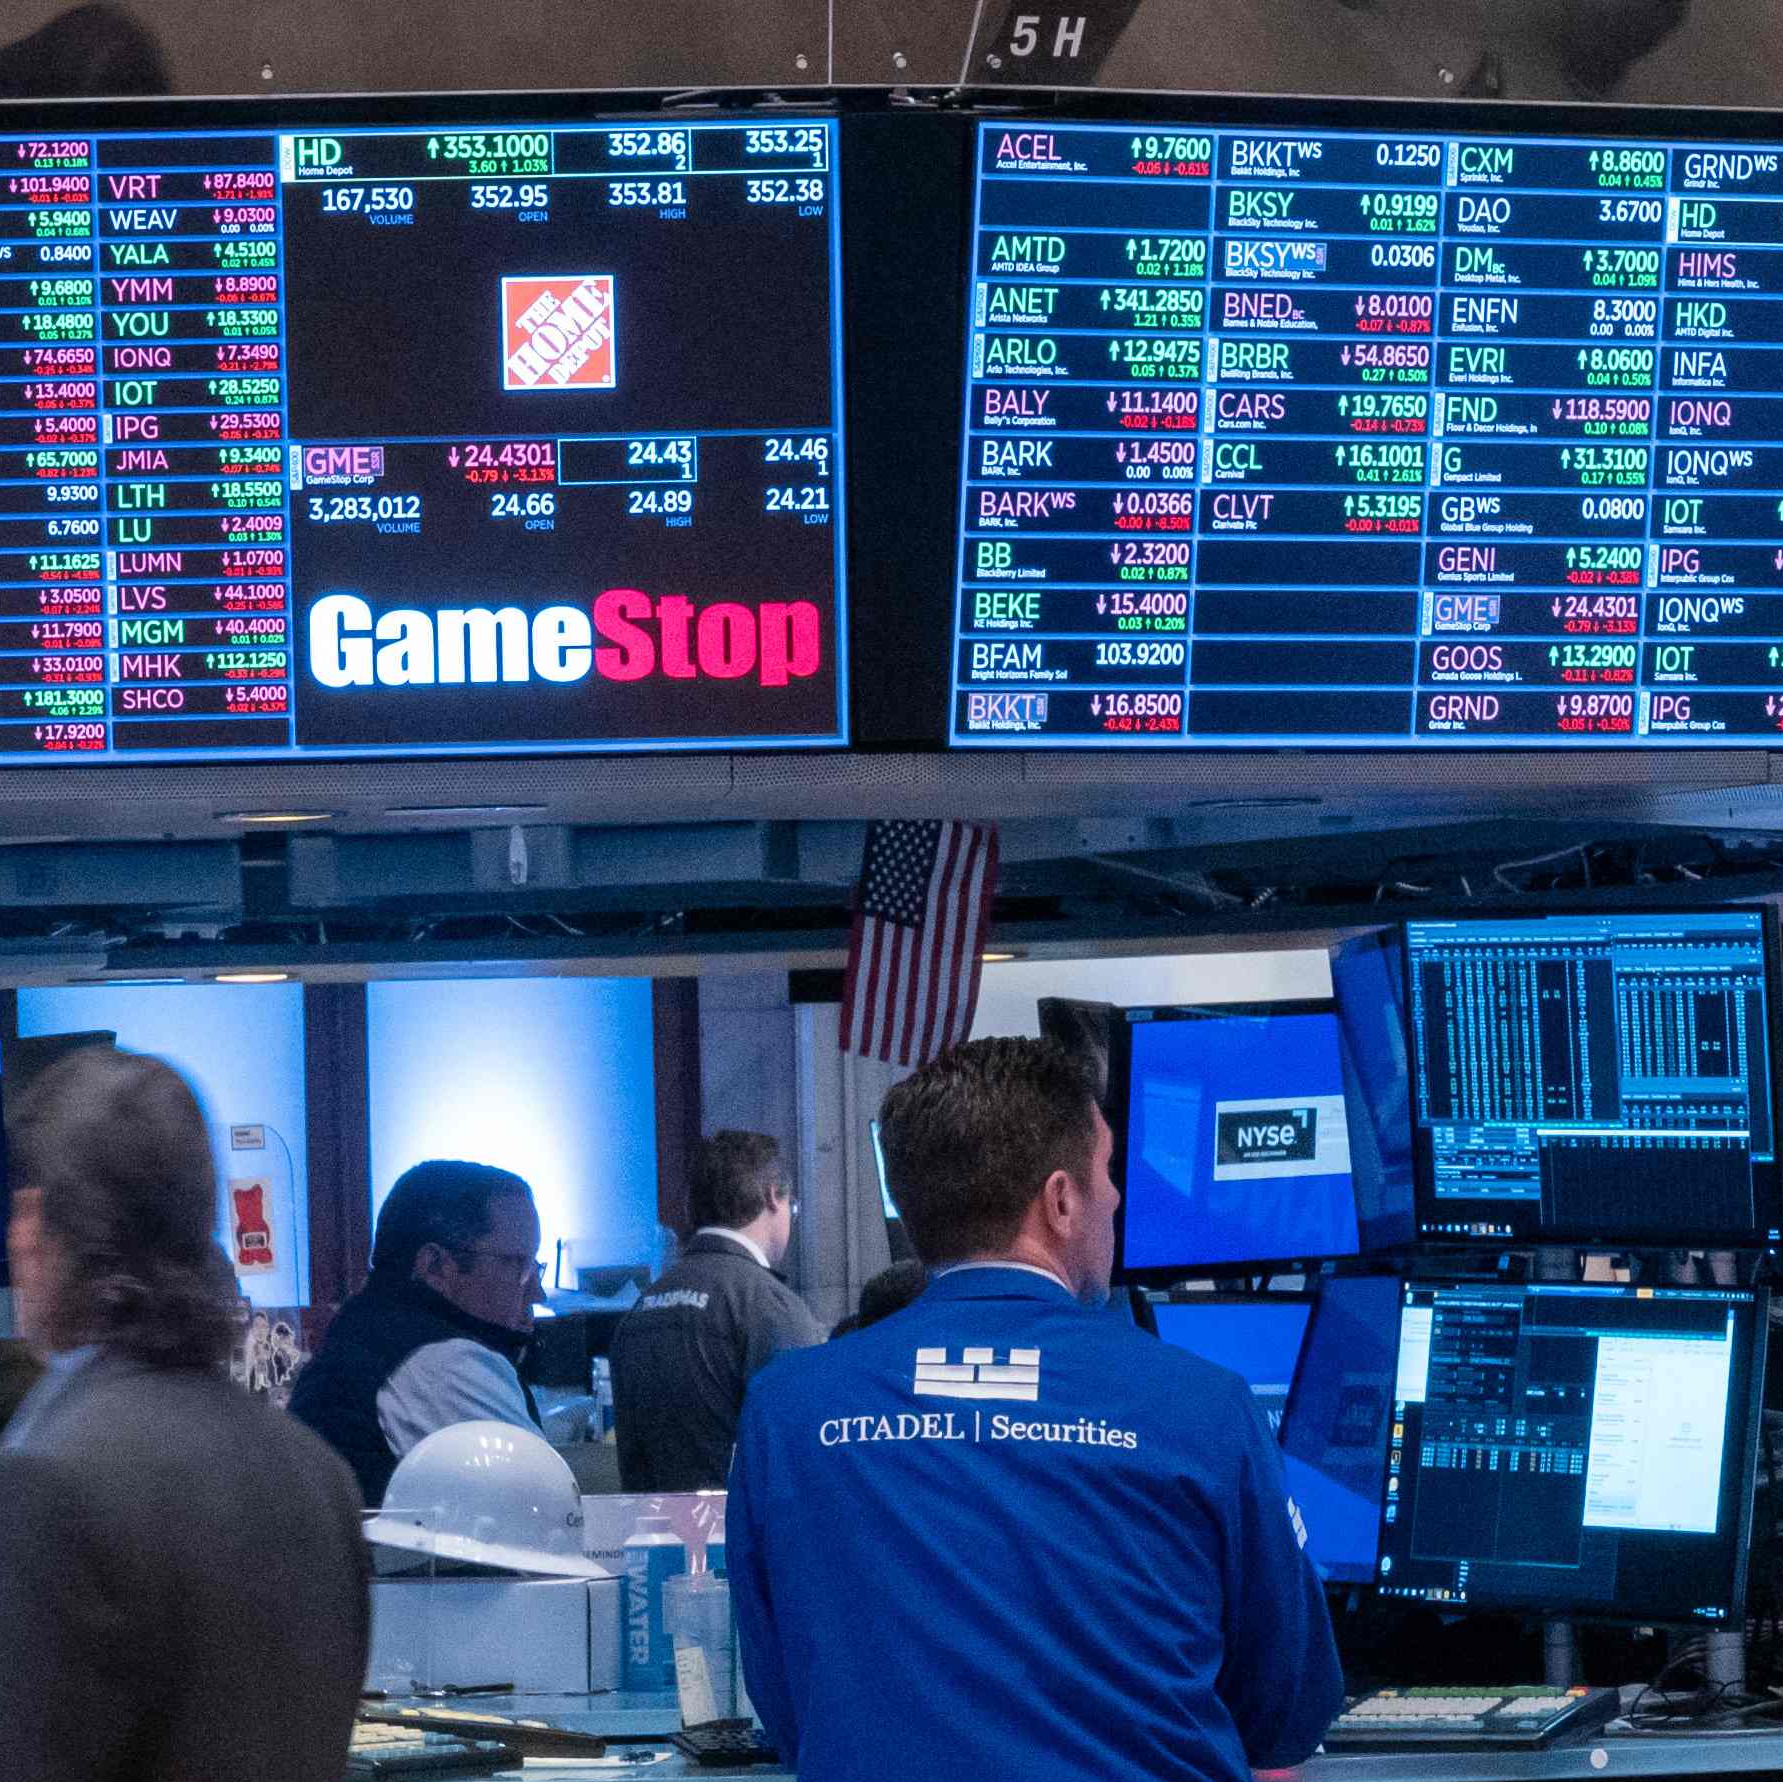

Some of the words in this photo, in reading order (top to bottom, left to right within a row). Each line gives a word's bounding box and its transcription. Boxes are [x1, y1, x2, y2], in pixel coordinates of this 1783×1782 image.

[29, 142, 89, 160] 72.1200
[298, 139, 342, 166] HD
[443, 134, 549, 158] 353.1000
[609, 132, 686, 156] 352.86
[746, 130, 823, 154] 353.25
[997, 135, 1062, 161] ACEL
[1144, 138, 1210, 161] 9.7600
[1460, 148, 1514, 174] CXM
[1601, 151, 1665, 174] 8.8600
[298, 166, 324, 176] Home
[326, 166, 353, 176] Depot
[322, 188, 414, 214] 167,530
[1679, 253, 1736, 279] HIMS
[516, 289, 561, 334] THE
[989, 288, 1059, 314] ANET
[1114, 290, 1204, 312] 341.2850
[112, 314, 170, 336] YOU
[217, 310, 277, 329] 18.3300
[509, 280, 610, 385] HOME
[1450, 348, 1506, 373] EVRI
[1590, 349, 1654, 371] 8.0600
[306, 449, 370, 476] GME
[464, 443, 556, 468] 24.4301
[629, 441, 692, 464] 24.43
[766, 439, 829, 461] 24.46
[983, 441, 1052, 467] BARK
[1130, 441, 1195, 463] 1.4500
[307, 474, 351, 485] GameStop
[352, 474, 374, 484] Corp
[309, 496, 420, 522] 3,283,012
[48, 519, 99, 537] 6.7600
[309, 588, 820, 688] GameStop
[972, 644, 1042, 669] BFAM
[1096, 644, 1184, 666] 103.9200
[819, 1413, 965, 1447] CITADEL
[991, 1415, 1137, 1449] Securities
